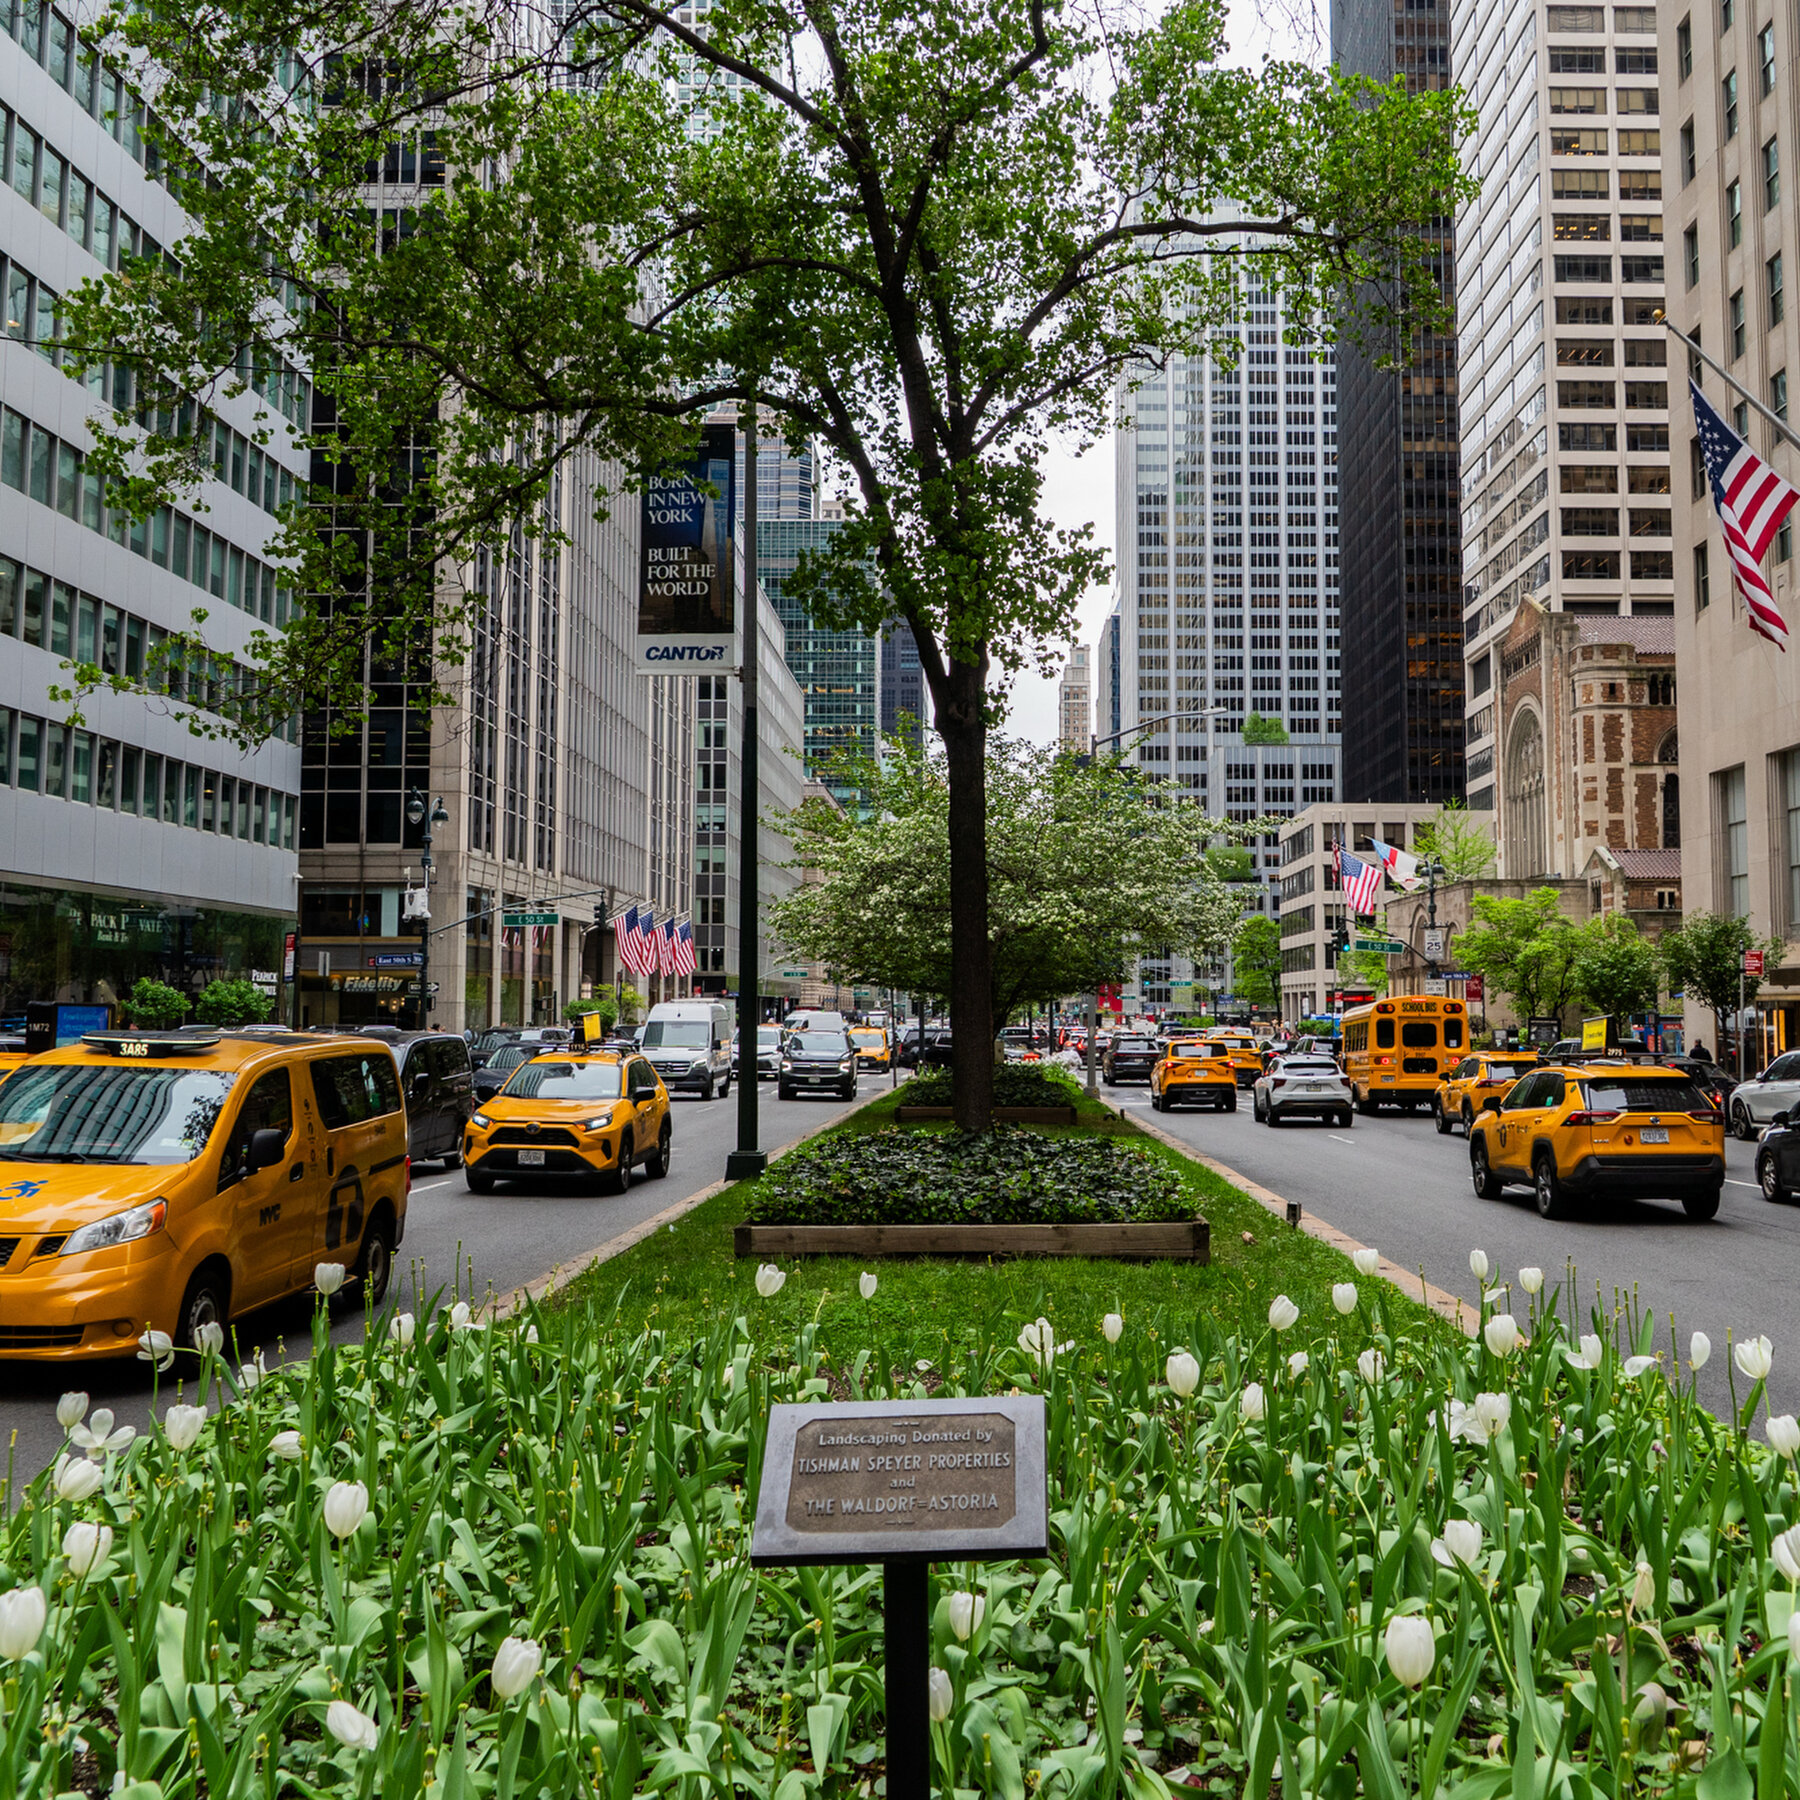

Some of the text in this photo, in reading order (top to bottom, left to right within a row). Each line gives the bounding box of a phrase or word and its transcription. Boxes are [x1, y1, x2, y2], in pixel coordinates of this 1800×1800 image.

[649, 474, 696, 490] BORN
[649, 491, 707, 507] IN NEW
[649, 509, 693, 524] YORK
[648, 546, 692, 563] BUILT
[647, 563, 716, 580] FOR THE
[646, 580, 710, 597] WORLD
[645, 646, 726, 661] CANTOR
[525, 916, 535, 924] 50
[1427, 942, 1441, 951] 25
[344, 976, 403, 991] Fidelity
[1402, 1002, 1437, 1012] SCHOOL BUS
[28, 1022, 50, 1032] 1M72
[119, 1043, 148, 1056] 3A85
[259, 1204, 281, 1226] NYC
[818, 1428, 993, 1448] Landscaping Donated by
[798, 1452, 1011, 1475] TISHMAN SPEYER PROPERTIES
[889, 1476, 915, 1489] and
[805, 1499, 835, 1516] THE
